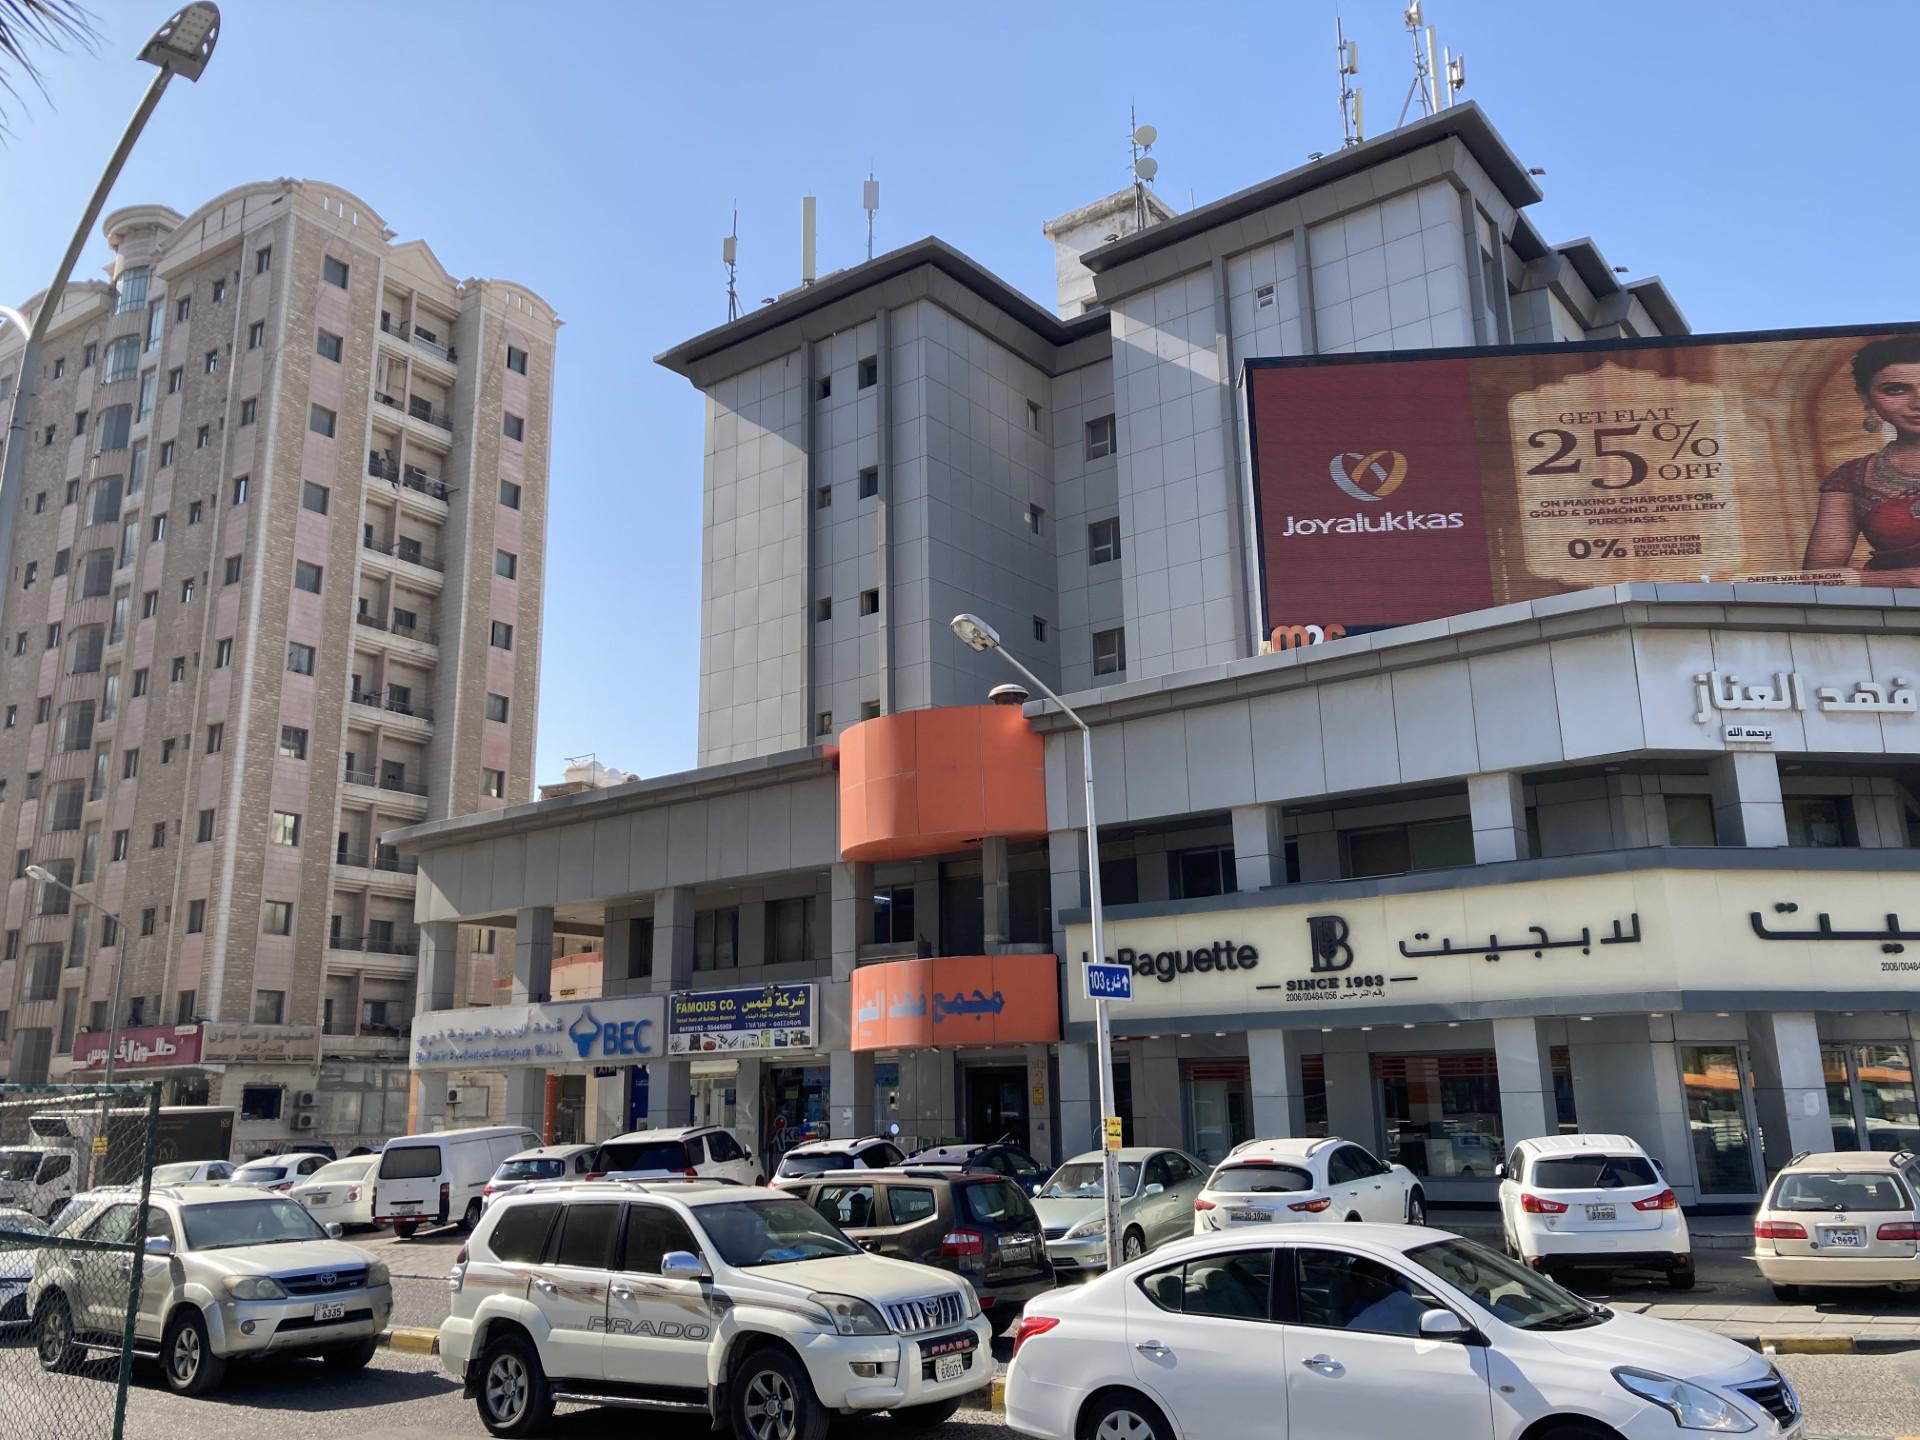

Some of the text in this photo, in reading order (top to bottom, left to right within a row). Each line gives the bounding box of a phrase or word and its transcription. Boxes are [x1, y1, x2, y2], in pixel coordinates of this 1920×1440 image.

[1559, 407, 1674, 425] GET FLAT
[1527, 419, 1720, 490] 25%
[1658, 463, 1722, 481] OFF
[1540, 492, 1713, 509] ON MAKING CHARGES FOR
[1529, 509, 1568, 519] GOLD
[1583, 506, 1648, 516] DIAMOND
[1651, 502, 1727, 513] JEWELLERY
[1282, 511, 1465, 537] Joyalukkas
[1632, 534, 1701, 544] DEDUCTION
[1567, 538, 1628, 560] 0%
[1634, 548, 1703, 557] EXCHANGE
[1694, 671, 1919, 724] فهد العناز
[1090, 970, 1121, 992] شارع 103
[1286, 974, 1385, 991] SINCE 1983
[676, 999, 737, 1014] FAMOUS CO.
[603, 1019, 653, 1056] BEC
[587, 1315, 711, 1341] PRADO
